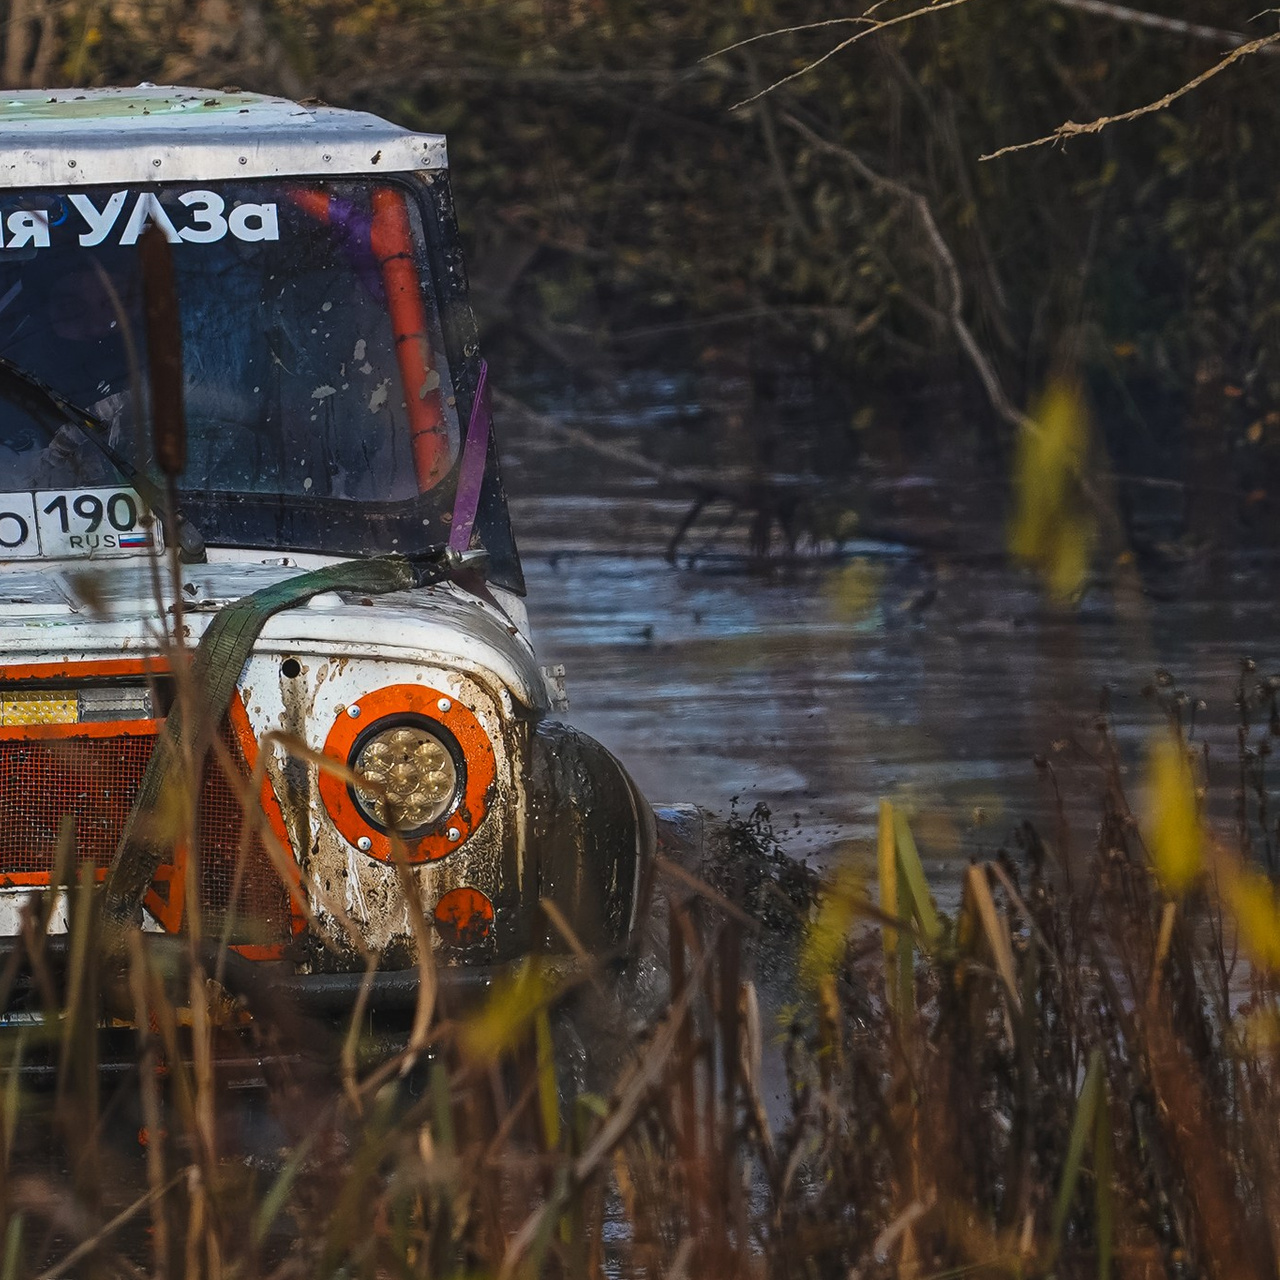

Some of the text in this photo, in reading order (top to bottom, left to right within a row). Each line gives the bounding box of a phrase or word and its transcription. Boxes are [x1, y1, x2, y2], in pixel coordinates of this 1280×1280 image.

[67, 189, 280, 248] УАЗа
[43, 492, 137, 533] 190
[69, 534, 117, 548] RUS
